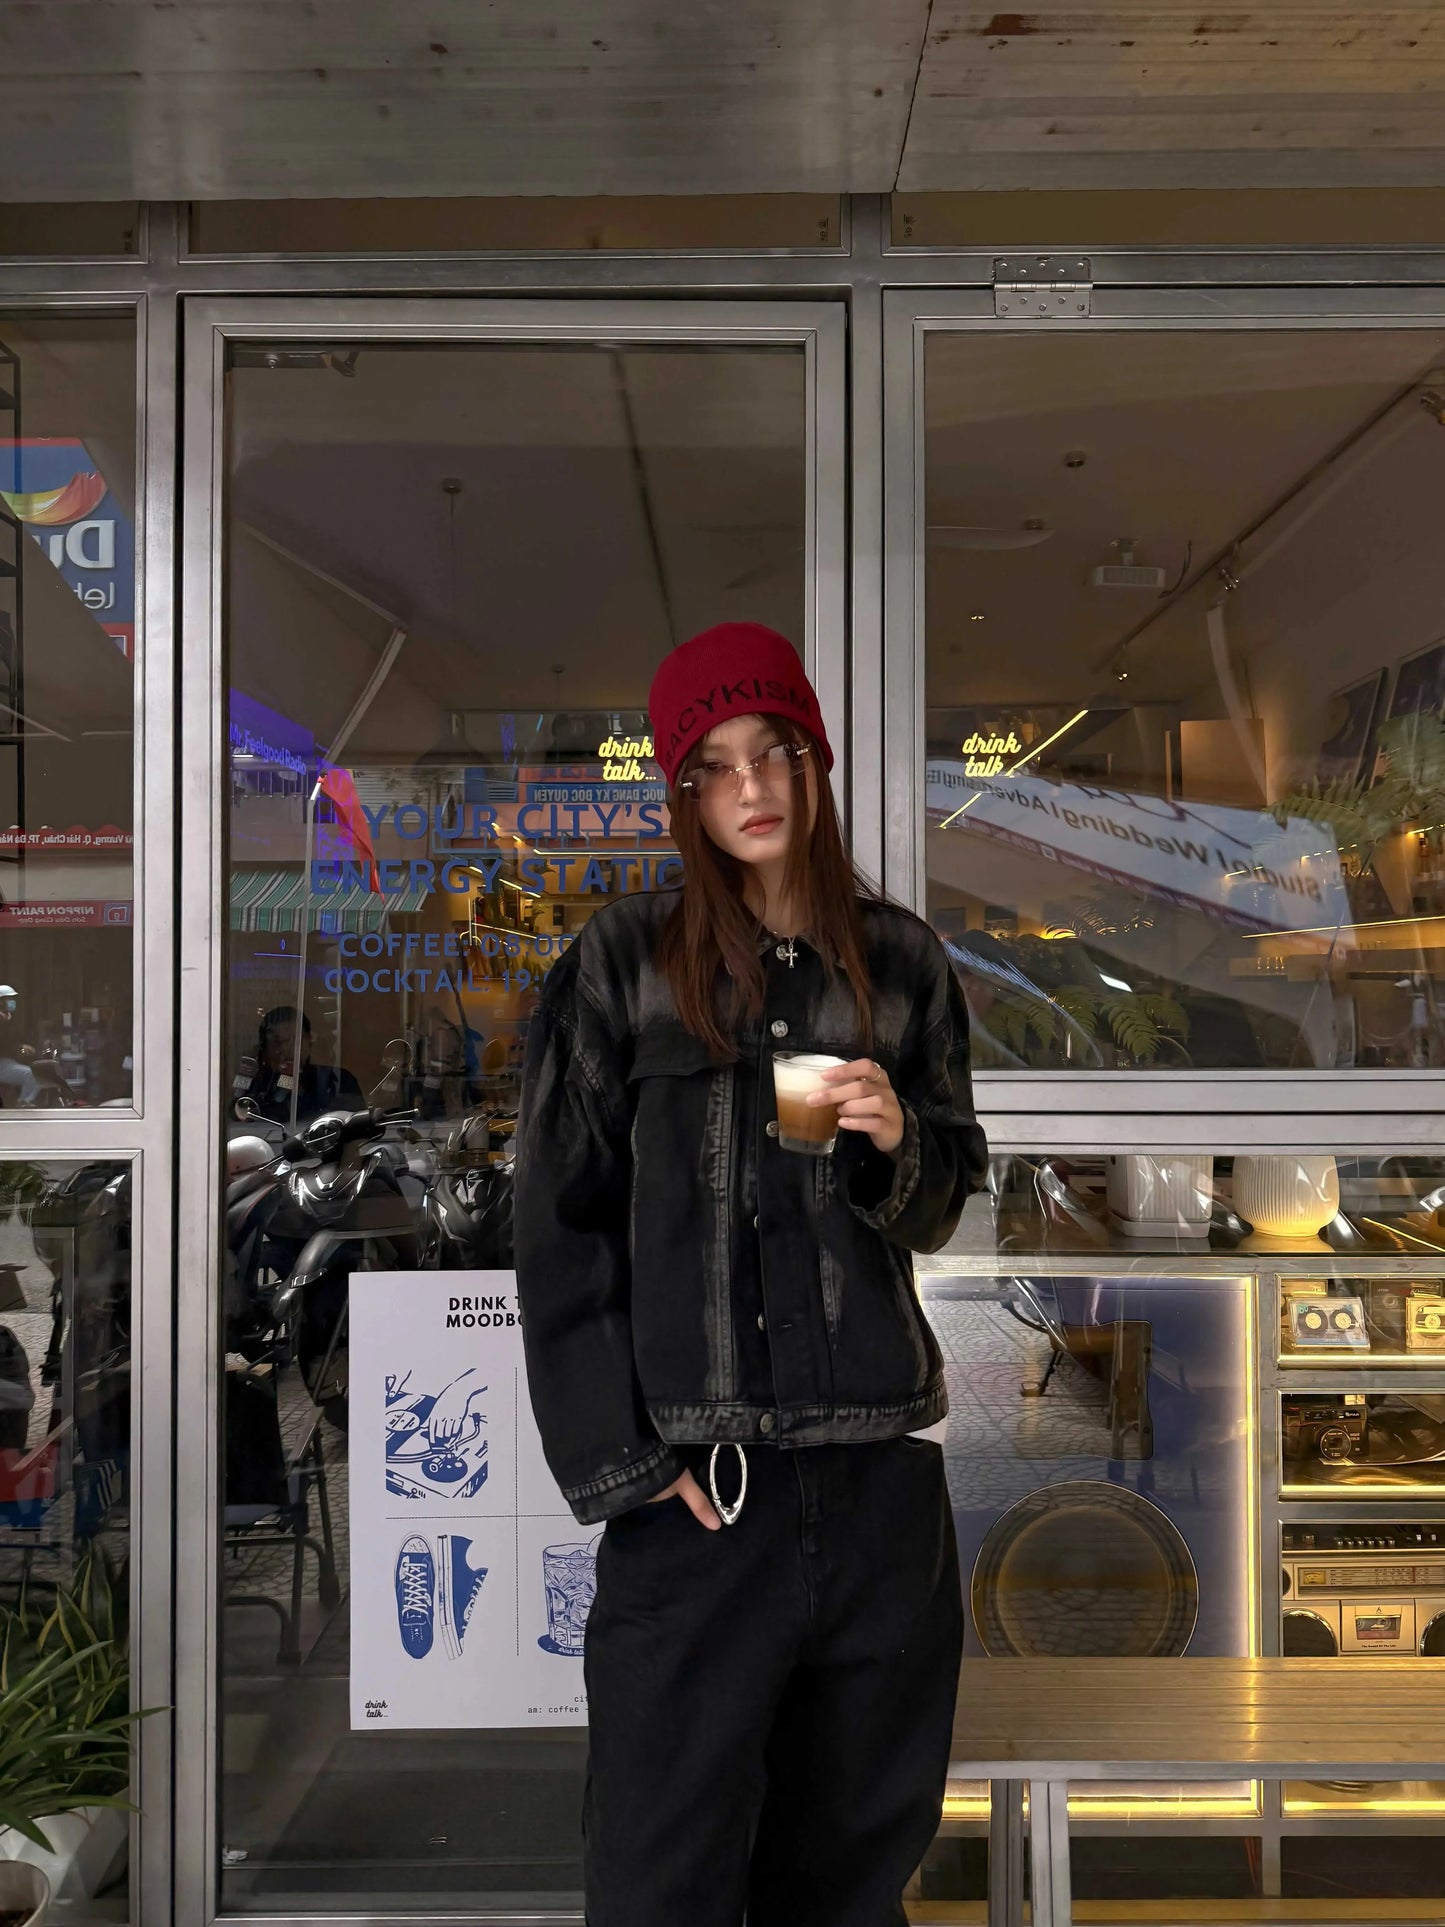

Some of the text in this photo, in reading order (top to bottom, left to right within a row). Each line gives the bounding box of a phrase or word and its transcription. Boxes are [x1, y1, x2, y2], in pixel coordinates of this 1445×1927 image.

[245, 729, 285, 766] Feelgood
[285, 749, 307, 776] Radio
[598, 735, 655, 758] drink
[962, 731, 1022, 754] drink
[366, 803, 500, 840] YOUR
[311, 858, 504, 895] ENERGY
[339, 932, 474, 958] COFFEE:
[325, 968, 551, 993] COCKTAIL: 19:
[449, 1296, 508, 1311] DRINK
[365, 1699, 389, 1709] drink
[548, 1705, 580, 1714] coffee
